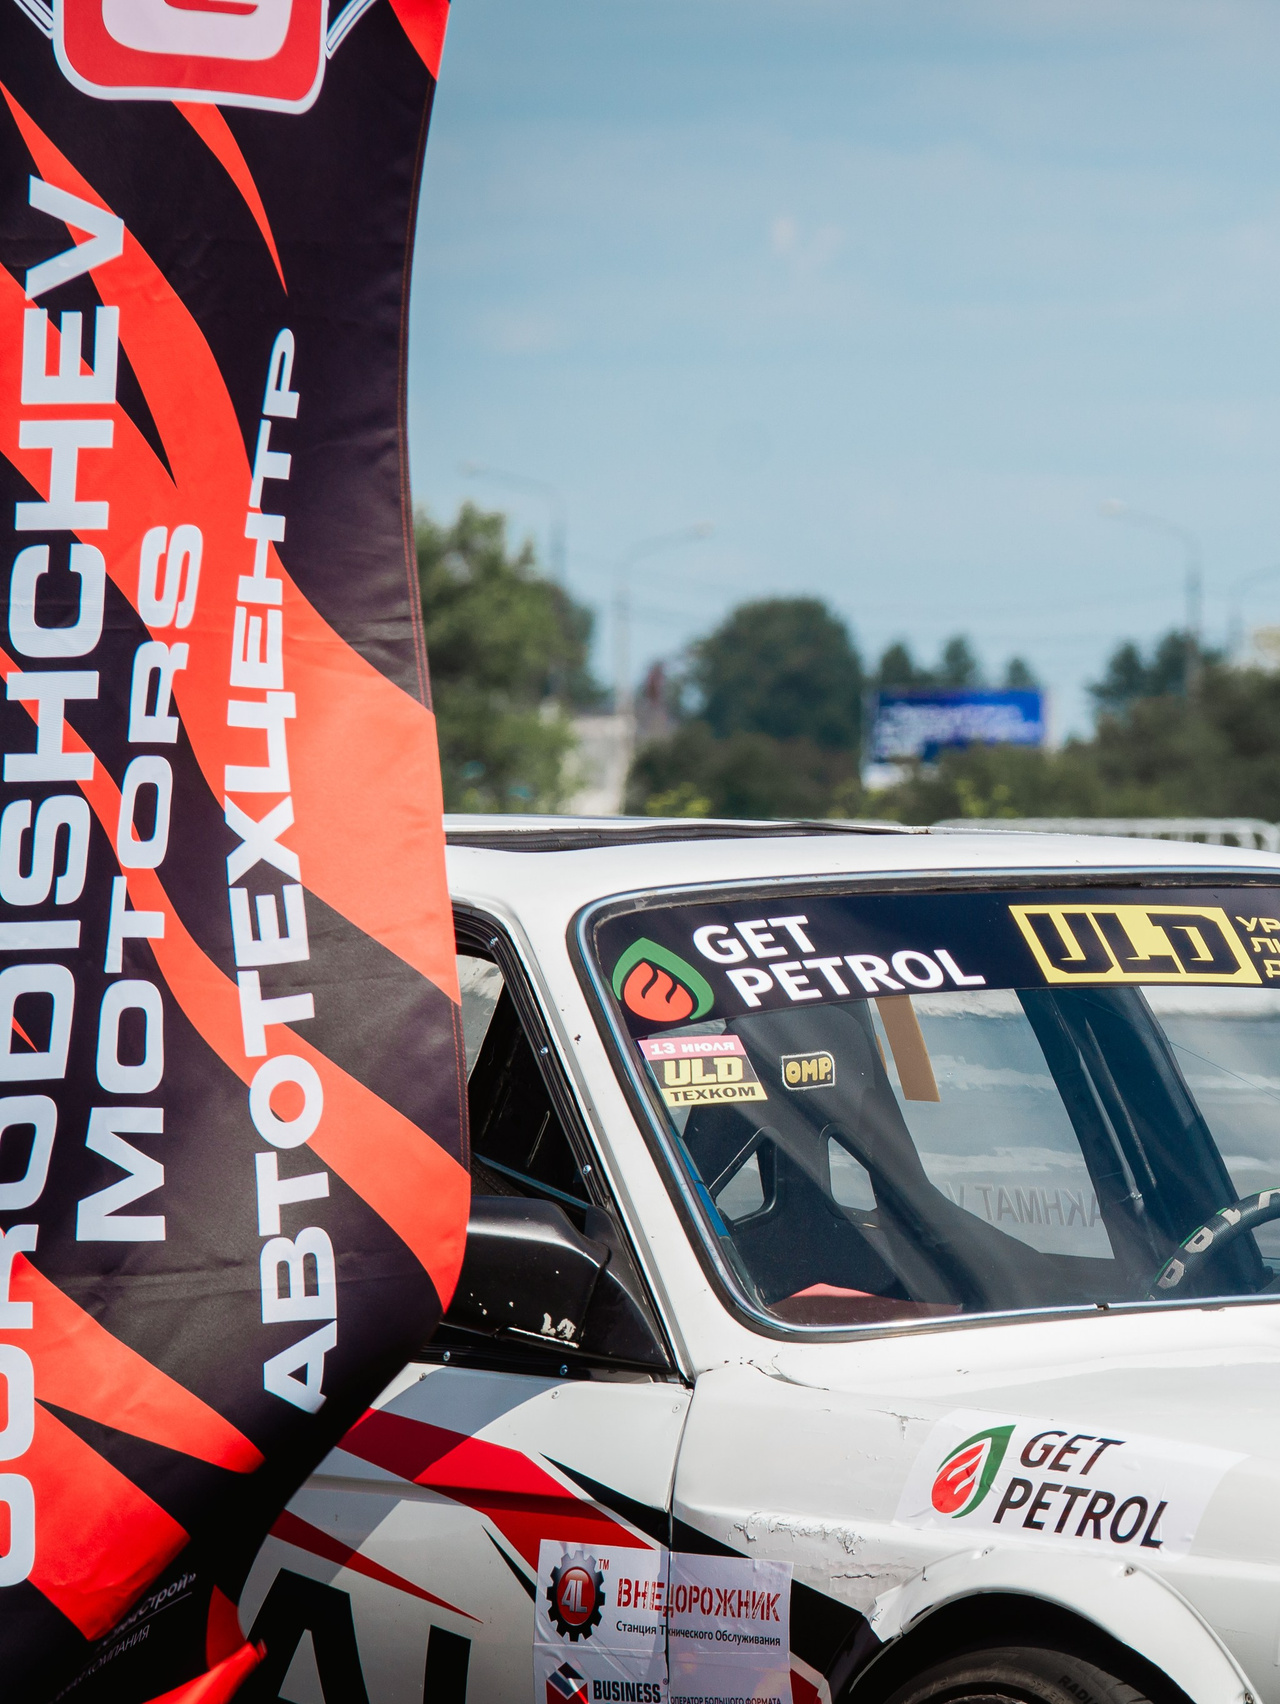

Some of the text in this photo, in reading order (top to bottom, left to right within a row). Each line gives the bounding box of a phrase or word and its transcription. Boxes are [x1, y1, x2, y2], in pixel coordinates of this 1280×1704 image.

[76, 524, 203, 1242] MOTORS
[223, 328, 338, 1414] АВТОТЕХЦЕНТР
[692, 914, 815, 966] GET
[1018, 909, 1252, 978] ULD
[725, 948, 987, 1008] PETROL
[650, 1043, 676, 1055] 13
[785, 1057, 832, 1084] OMP
[664, 1056, 743, 1087] ULD
[670, 1086, 756, 1102] ТЕХКОМ
[1020, 1430, 1127, 1476] GET
[992, 1477, 1169, 1549] PETROL
[562, 1579, 587, 1613] 4L
[617, 1578, 781, 1622] ВНЕДОРОЖНИК
[616, 1620, 781, 1647] Станция Тхнического Обслуживания
[593, 1680, 661, 1704] BUSINESS
